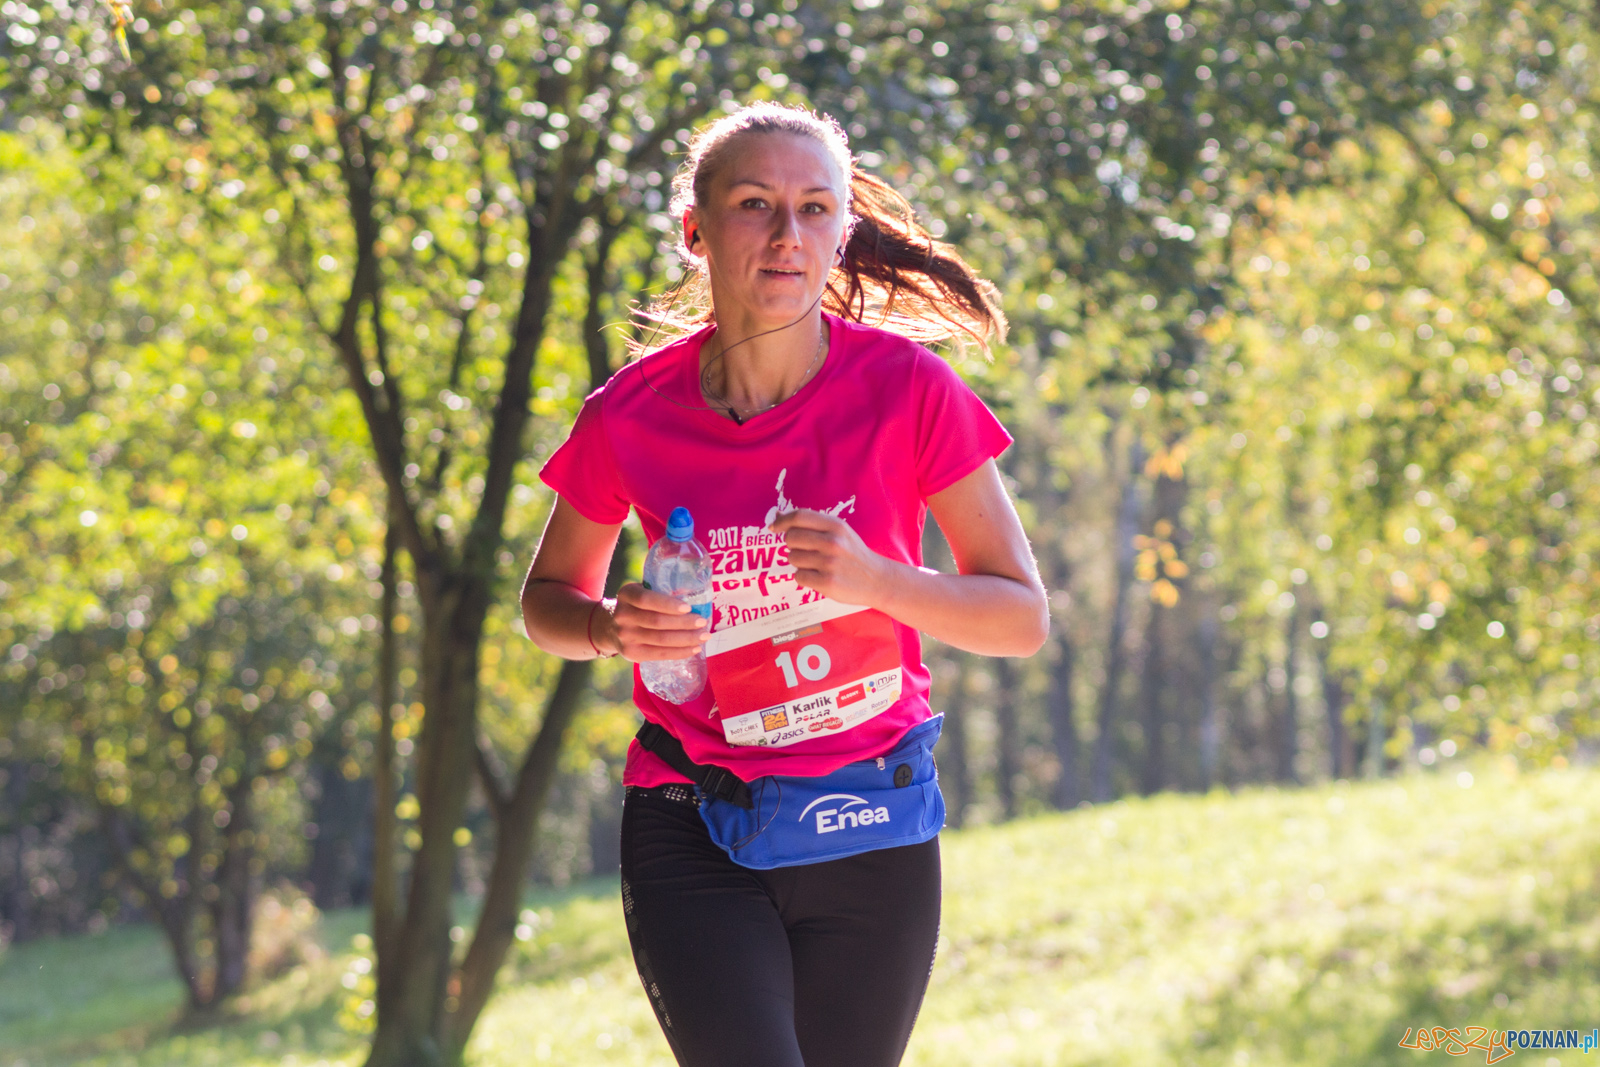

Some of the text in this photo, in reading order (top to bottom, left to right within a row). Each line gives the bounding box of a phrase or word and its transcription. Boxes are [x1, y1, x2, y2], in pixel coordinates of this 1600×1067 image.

[708, 526, 786, 549] 2017 BIEG K
[711, 545, 790, 575] zaws
[775, 644, 831, 688] 10
[792, 696, 832, 714] Karlik
[795, 709, 831, 724] POLAR
[763, 711, 786, 726] 24
[816, 806, 890, 834] Enea
